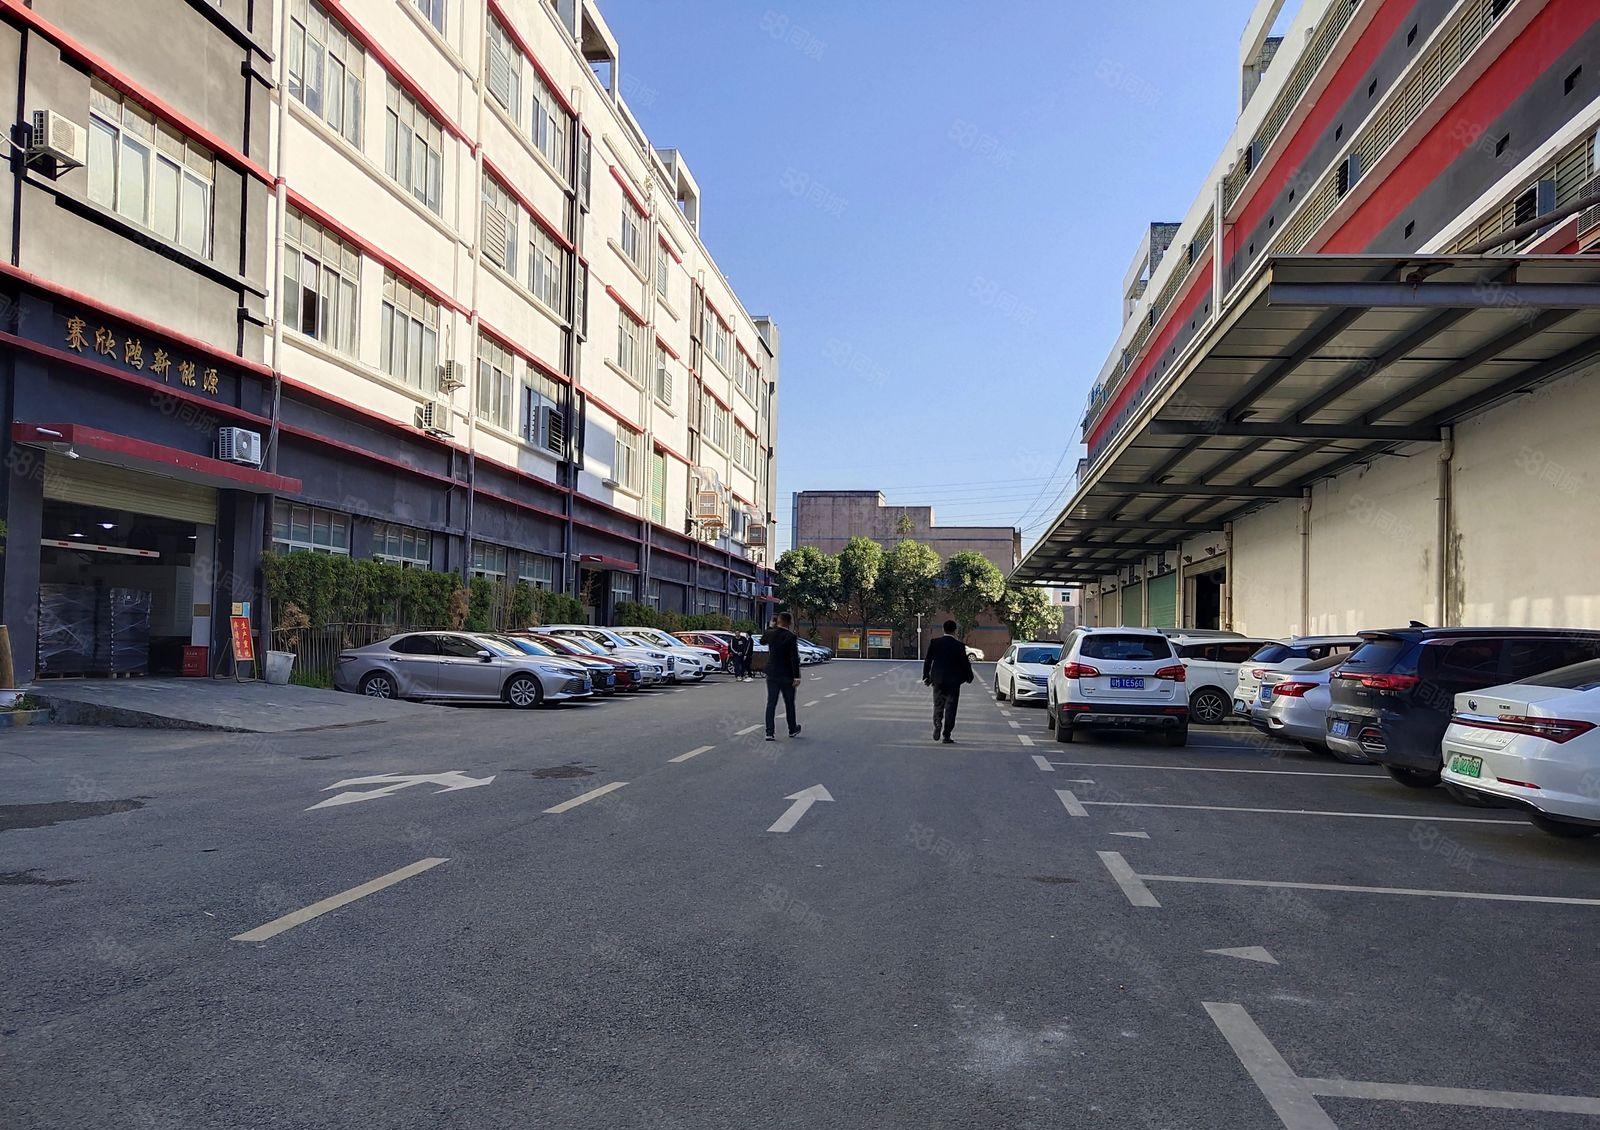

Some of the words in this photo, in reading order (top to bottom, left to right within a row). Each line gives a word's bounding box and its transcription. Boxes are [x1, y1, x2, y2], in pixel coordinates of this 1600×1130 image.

[65, 315, 219, 395] 赛欣鸿新能源
